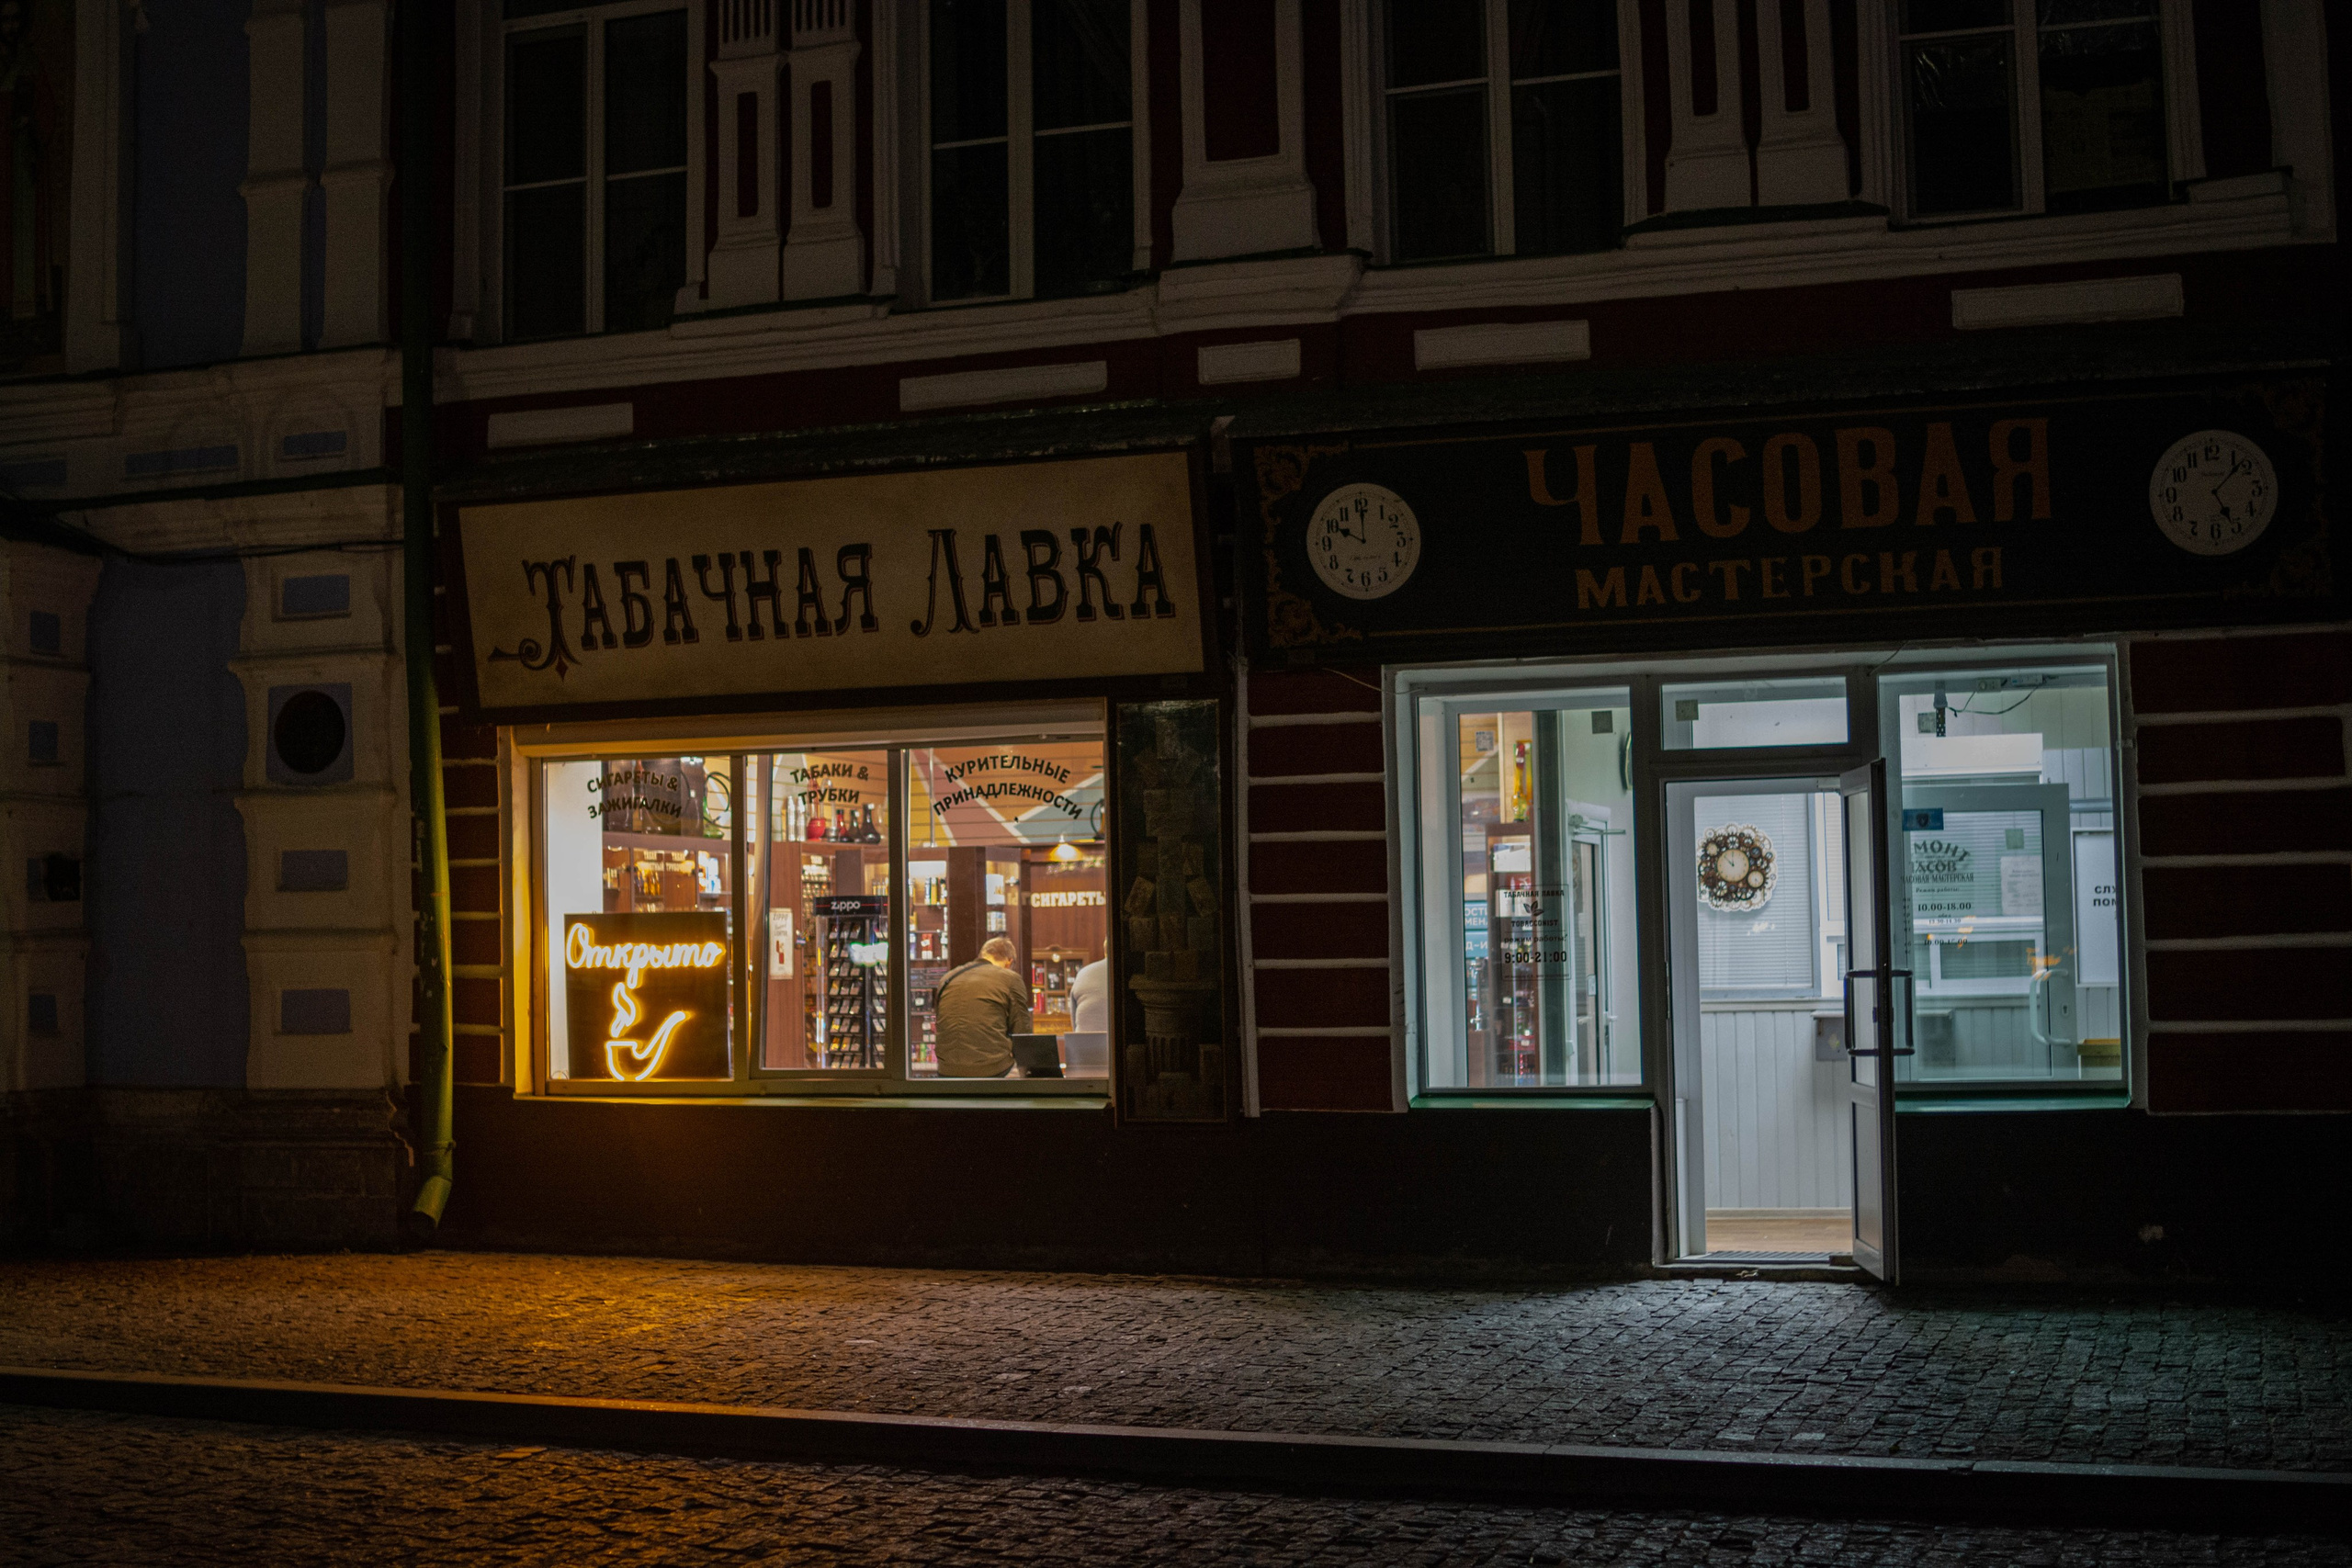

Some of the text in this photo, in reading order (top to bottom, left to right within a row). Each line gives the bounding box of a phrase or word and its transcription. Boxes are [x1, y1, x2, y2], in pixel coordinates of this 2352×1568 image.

[1522, 417, 2053, 546] ЧАСОВАЯ
[2174, 467, 2187, 482] 10
[2165, 488, 2177, 503] 9
[1327, 519, 1339, 534] 10
[1322, 536, 1331, 551] 9
[1329, 555, 1338, 570] 8
[1577, 546, 2005, 610] МАСТЕРСКАЯ
[491, 521, 1175, 671] ТАБАЧНАЯ ЛАВКА
[790, 763, 868, 784] ТАБАКИ &
[944, 754, 1071, 784] КУРИТЕЛЬНЫЕ
[587, 771, 678, 793] СИГАРЕТЫ &
[797, 788, 860, 806] ТРУБКИ
[933, 783, 1083, 819] ПРИНАДЛЕЖНОСТИ
[588, 796, 683, 818] ЗАЖИГАЛКИ
[1931, 872, 1974, 883] МАСТЕРСКАЯ
[1504, 890, 1539, 898] ТАБАЧНАЯ
[1917, 902, 1972, 911] 10.00-18.00
[1511, 919, 1559, 928] TOBACCONIST
[566, 922, 725, 989] Открыто
[1504, 951, 1567, 964] 9:00-21:00
